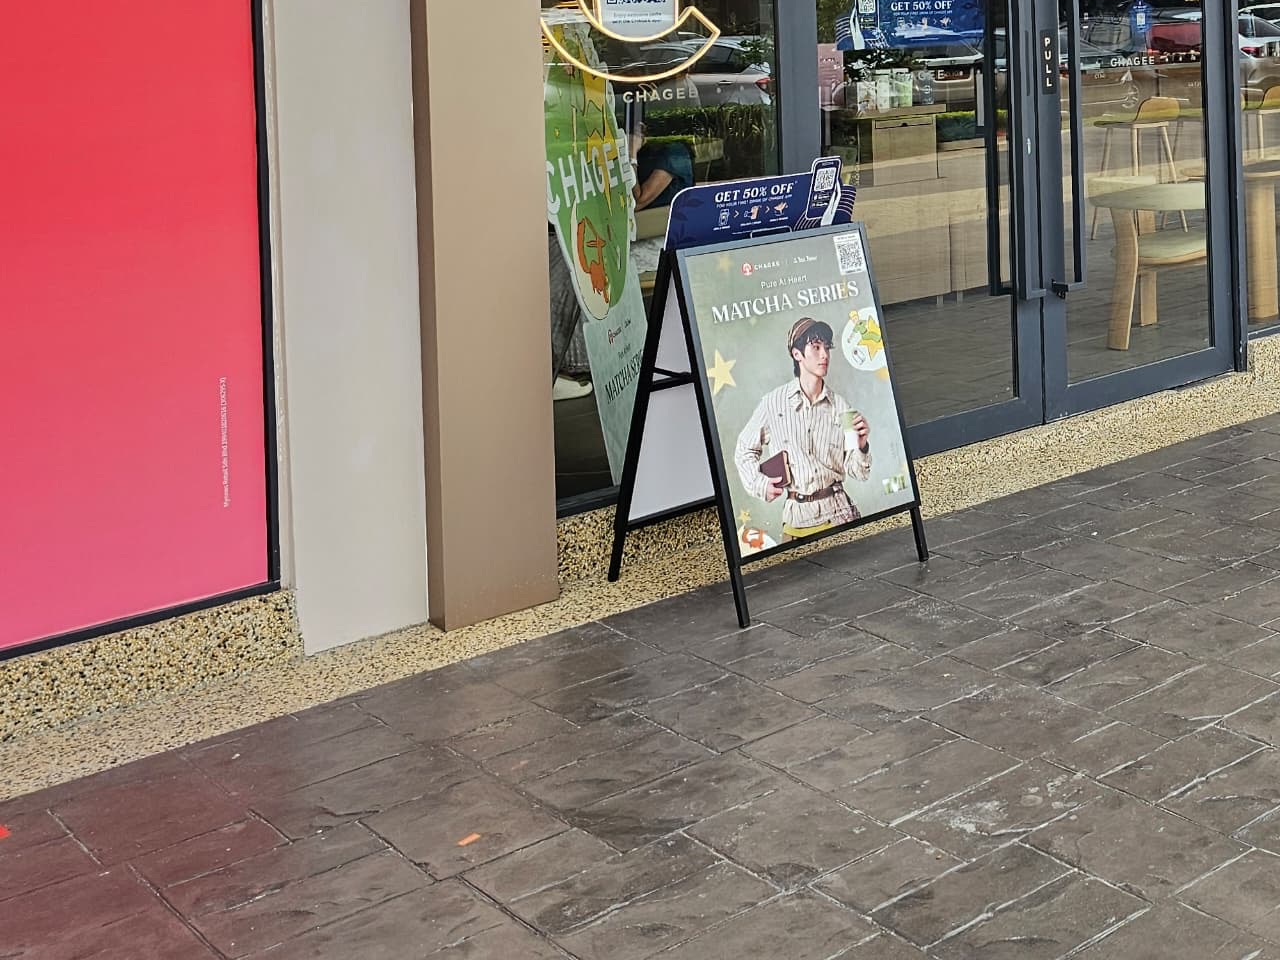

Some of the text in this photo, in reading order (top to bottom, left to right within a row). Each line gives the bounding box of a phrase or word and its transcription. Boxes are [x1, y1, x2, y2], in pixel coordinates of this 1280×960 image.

[890, 1, 911, 12] GET
[912, 0, 932, 11] 50%
[1044, 37, 1053, 88] PULL
[622, 87, 698, 104] CHAGEE
[714, 187, 742, 203] GET
[742, 185, 768, 199] 50%
[760, 279, 778, 289] Pure
[787, 274, 808, 285] Heart
[711, 280, 860, 325] MATCHA SERIES
[604, 363, 633, 405] MATCHA
